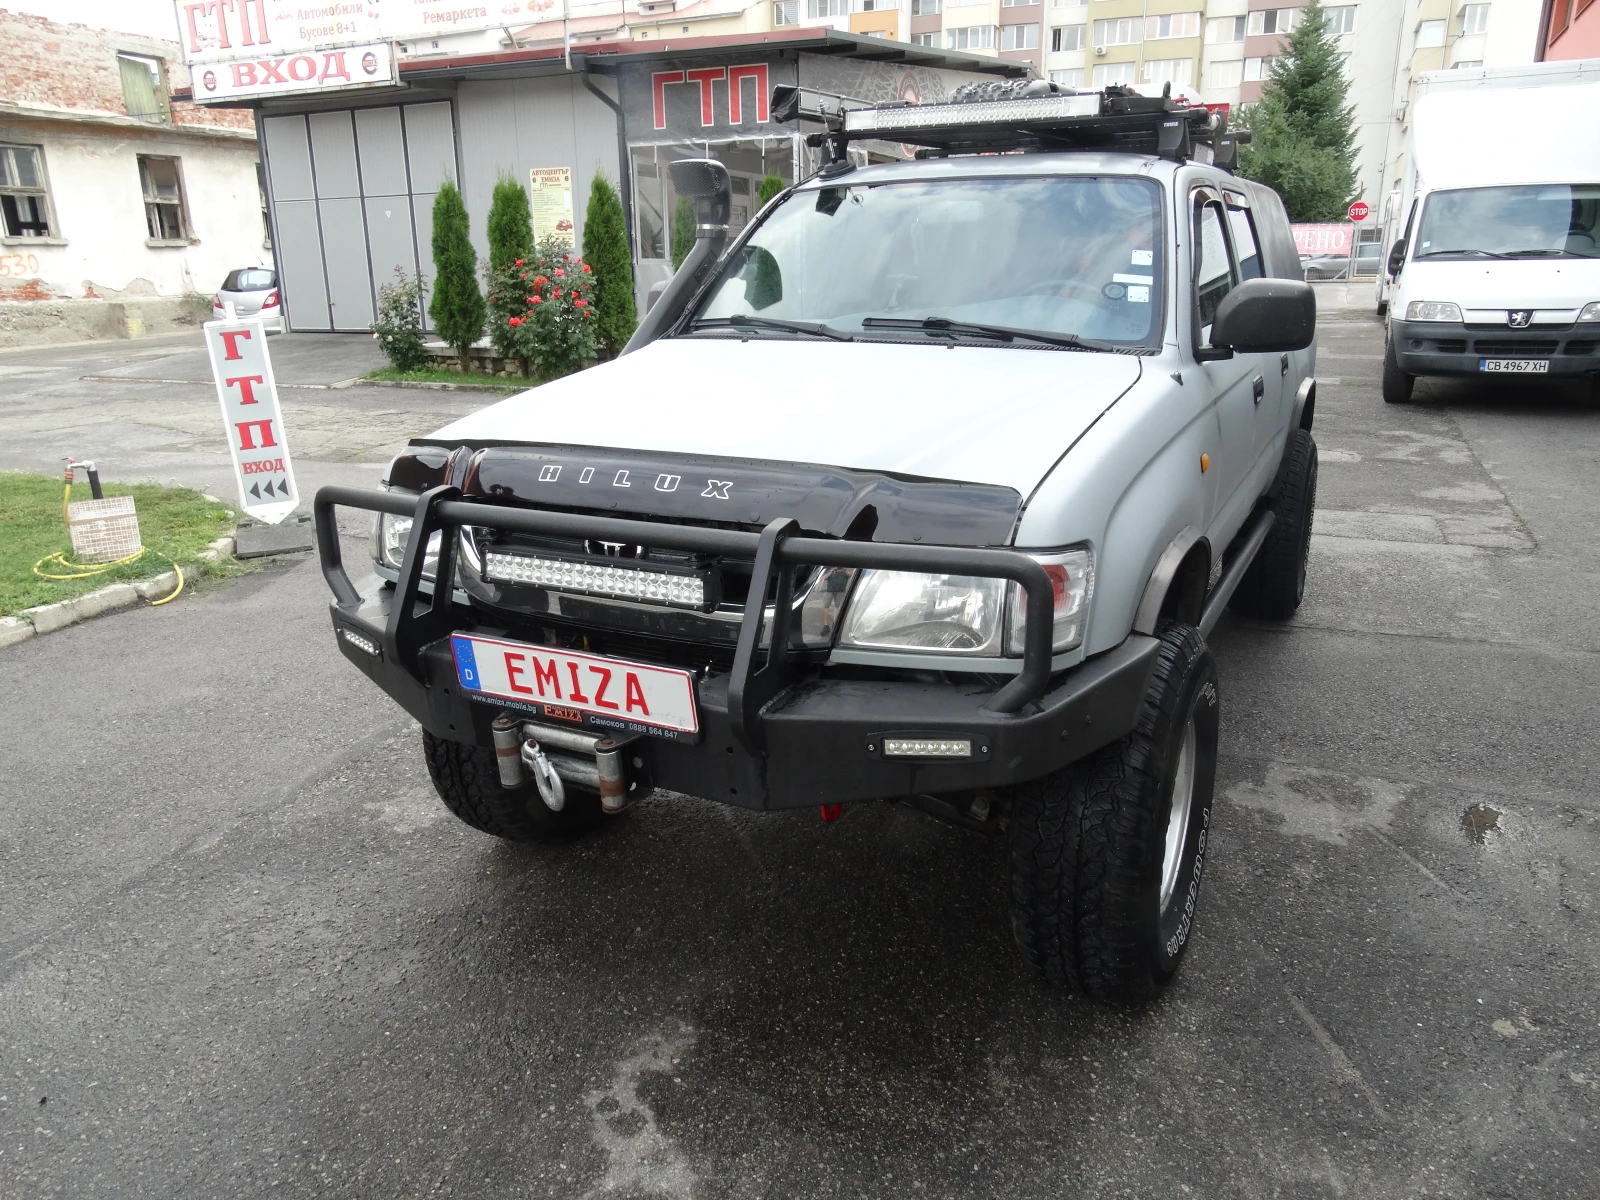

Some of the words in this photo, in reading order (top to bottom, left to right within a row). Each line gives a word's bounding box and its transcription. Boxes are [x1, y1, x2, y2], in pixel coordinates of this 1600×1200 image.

[297, 3, 363, 21] Автомобили
[423, 6, 487, 24] Ремаркета
[184, 0, 271, 53] ГТП
[299, 25, 334, 41] Бусове
[336, 20, 358, 35] 8+1
[230, 51, 351, 87] ВХОД
[652, 63, 770, 130] ГТП
[1350, 207, 1368, 217] STOP
[1503, 361, 1530, 371] 4967
[241, 458, 286, 475] ВХОД
[538, 465, 734, 500] HILUX
[465, 670, 473, 681] D
[503, 651, 650, 716] EMIZA
[471, 694, 537, 714] www.emiza.mobile.bg
[590, 716, 625, 729] Самоков
[629, 722, 647, 733] 0888
[648, 726, 663, 736] 564
[664, 729, 679, 739] 647
